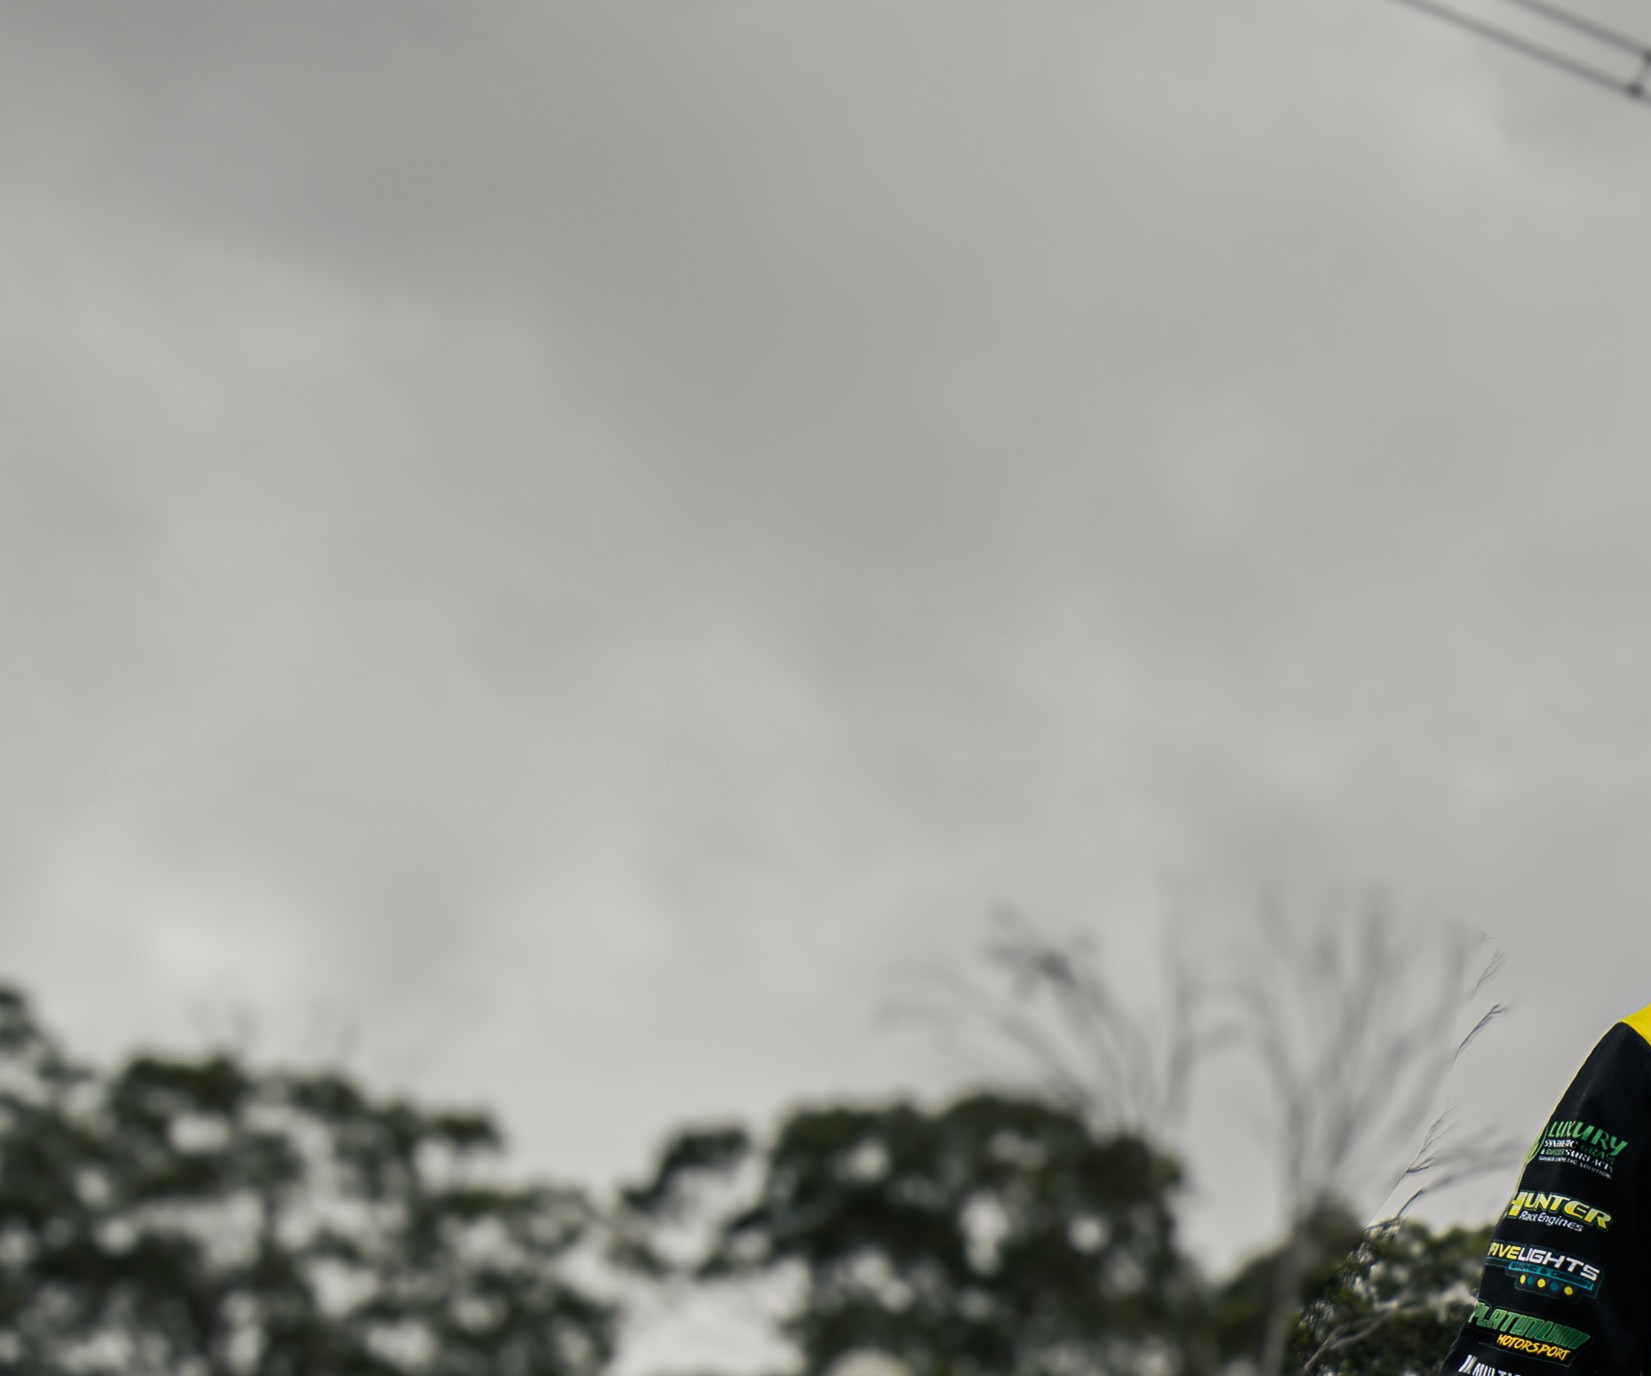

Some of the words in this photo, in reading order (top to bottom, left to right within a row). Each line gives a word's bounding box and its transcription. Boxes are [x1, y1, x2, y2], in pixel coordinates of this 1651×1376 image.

[1547, 1120, 1628, 1157] LUXURY
[1508, 1191, 1612, 1229] HUNTER
[1537, 1212, 1585, 1232] Engines
[1496, 1333, 1571, 1361] MOTORSPORT
